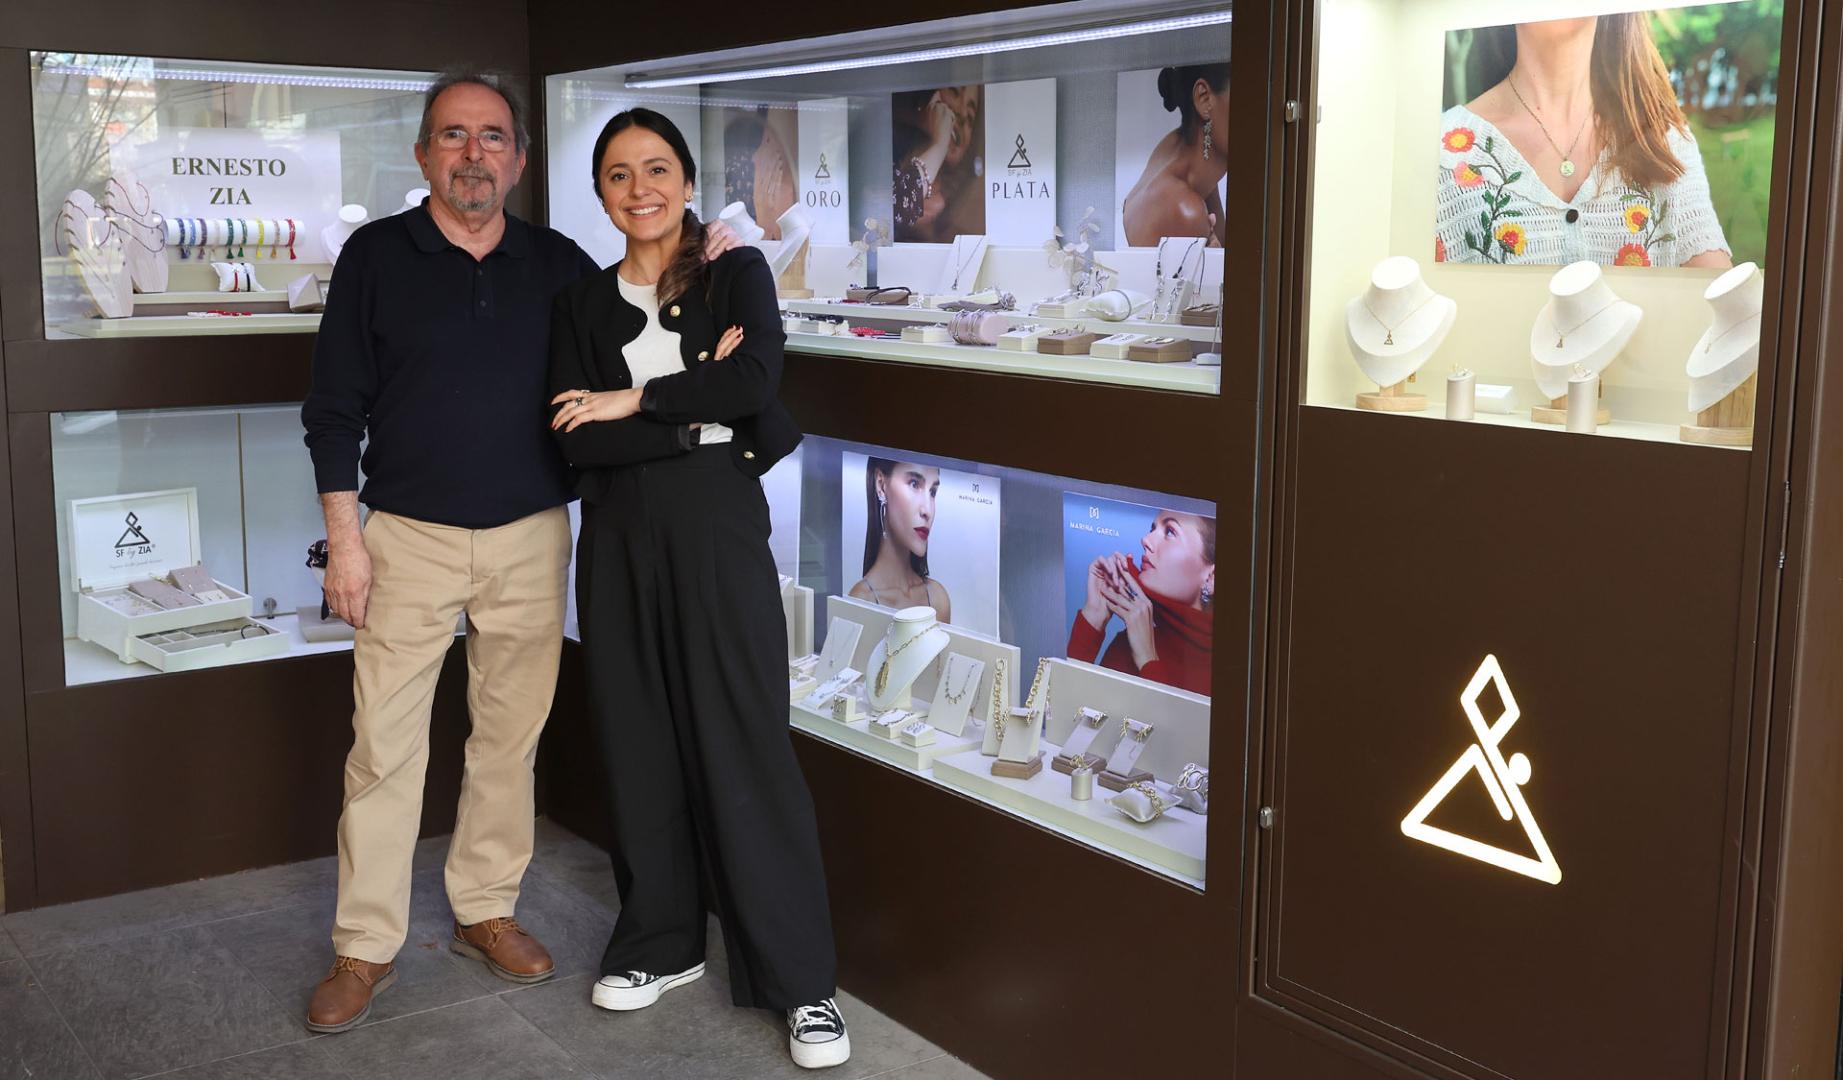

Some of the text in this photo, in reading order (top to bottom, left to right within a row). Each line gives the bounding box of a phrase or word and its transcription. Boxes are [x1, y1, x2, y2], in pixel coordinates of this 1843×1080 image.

[171, 157, 286, 176] ERNESTO
[209, 187, 252, 205] ZIA
[806, 190, 841, 208] ORO
[992, 181, 1050, 199] PLATA
[1070, 521, 1093, 532] MARINA
[115, 549, 125, 558] SF
[138, 545, 152, 555] ZIA
